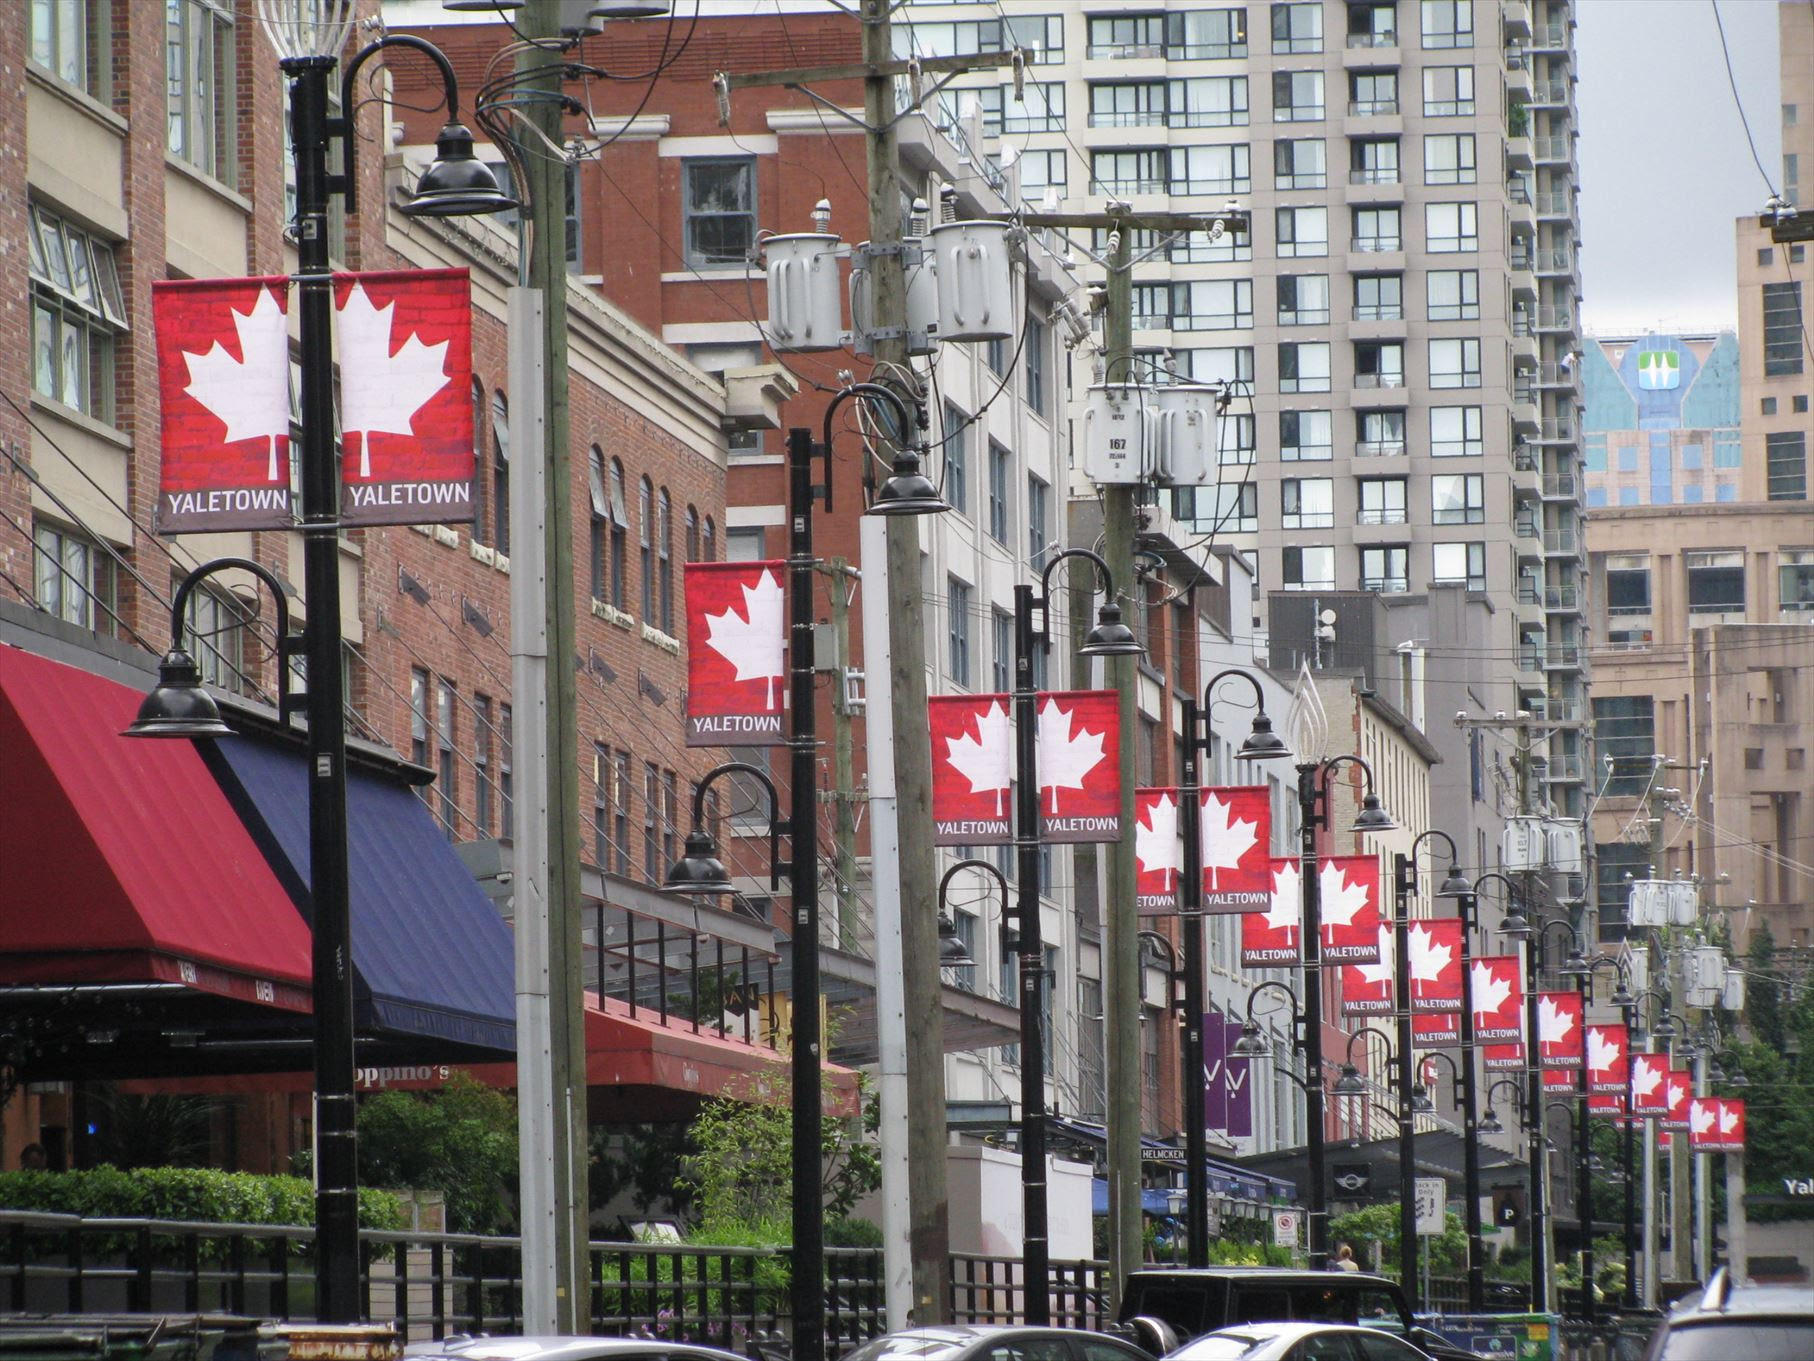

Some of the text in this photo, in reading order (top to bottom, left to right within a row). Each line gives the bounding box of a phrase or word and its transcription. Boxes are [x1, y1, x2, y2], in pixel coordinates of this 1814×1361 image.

[1109, 438, 1126, 450] 167
[350, 482, 469, 506] YALETOWN
[168, 489, 287, 514] YALETOWN
[693, 716, 781, 732] YALETOWN
[937, 821, 1009, 835] YALETOWN
[1046, 817, 1118, 832] YALETOWN
[1137, 895, 1175, 907] ETOWN
[1208, 893, 1268, 905] YALETOWN
[1245, 949, 1297, 960] YALETOWN
[1324, 946, 1377, 958] YALETOWN
[1345, 1000, 1391, 1010] YALETOWN
[1414, 999, 1461, 1009] YALETOWN
[1415, 1032, 1457, 1041] YALETOWN
[1477, 1028, 1520, 1038] YALETOWN
[1486, 1059, 1524, 1067] YALETOWN
[1543, 1056, 1581, 1065] YALETOWN
[354, 1065, 449, 1088] oppino's
[1543, 1084, 1573, 1092] ALETOWN
[1593, 1083, 1627, 1091] YALETOWN
[1142, 1150, 1184, 1159] HELMCKEN
[1504, 1208, 1515, 1220] P
